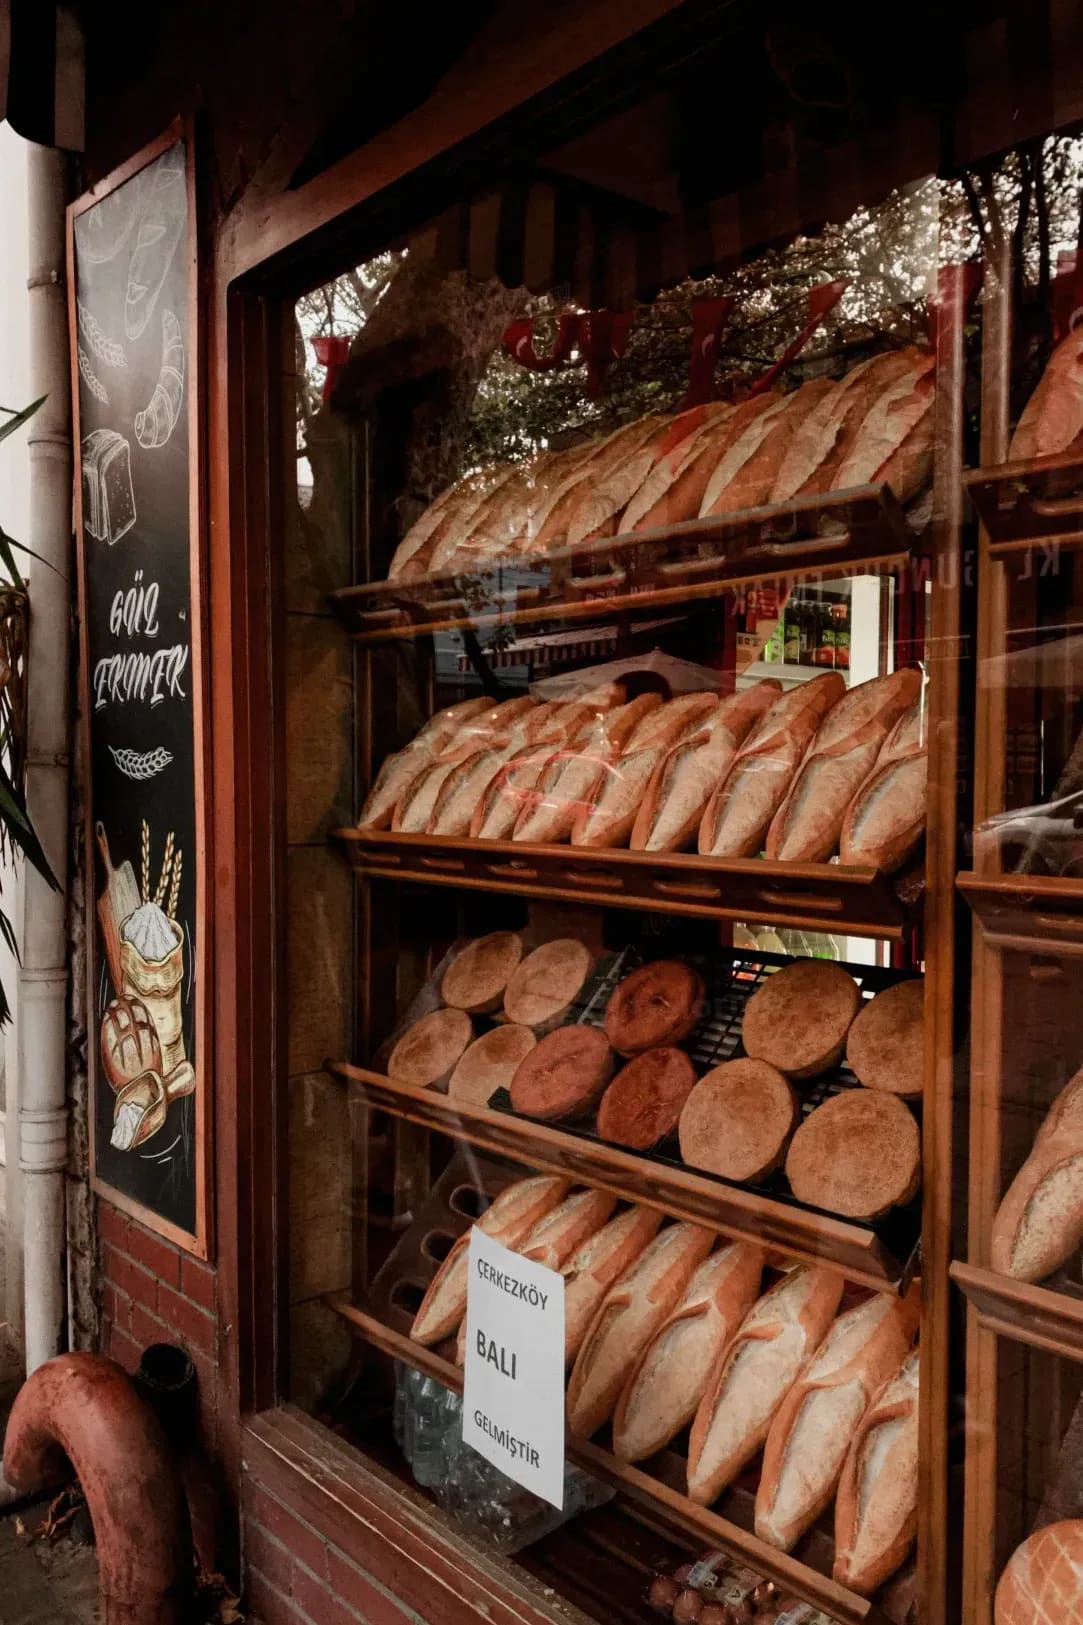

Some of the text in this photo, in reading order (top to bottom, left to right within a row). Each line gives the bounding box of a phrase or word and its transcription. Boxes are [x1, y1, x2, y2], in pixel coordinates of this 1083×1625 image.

[110, 569, 160, 637] GÜL
[93, 644, 189, 709] EKMEK
[477, 1258, 548, 1310] ÇERKEZKÖY
[476, 1328, 517, 1380] BALI
[474, 1410, 540, 1469] GELMİŞTİR
